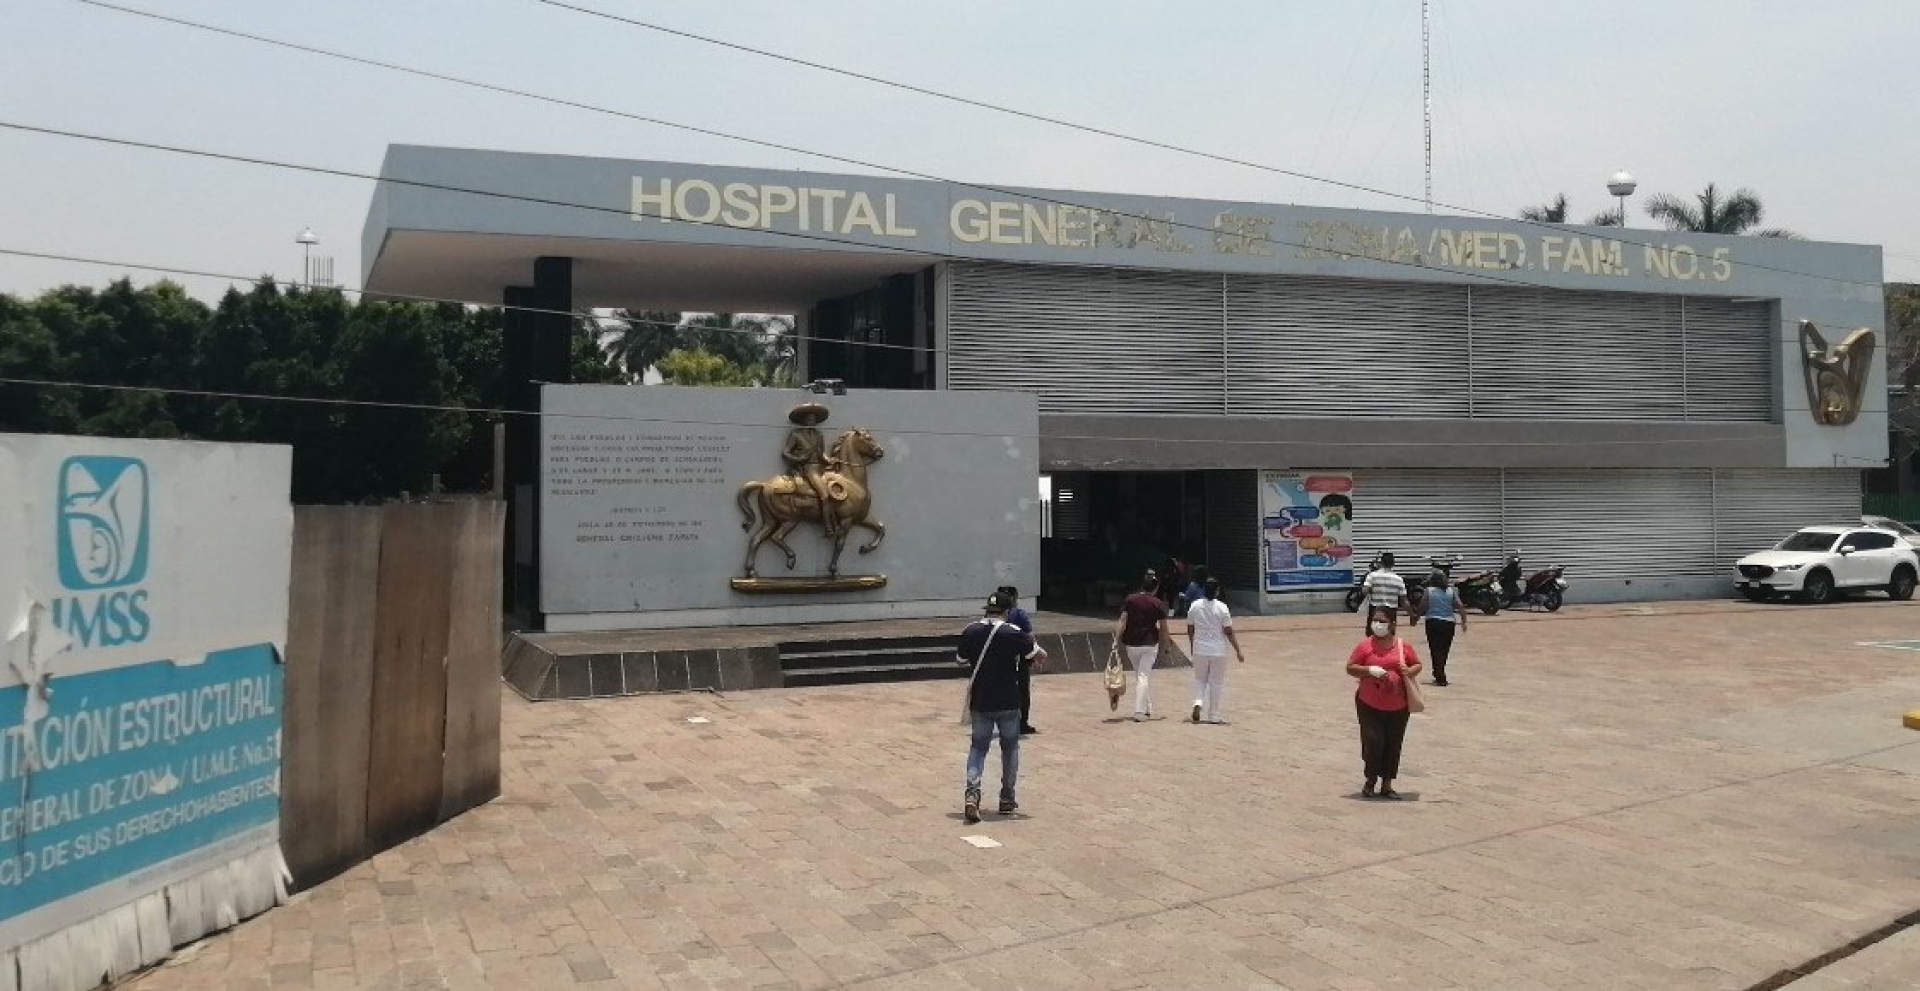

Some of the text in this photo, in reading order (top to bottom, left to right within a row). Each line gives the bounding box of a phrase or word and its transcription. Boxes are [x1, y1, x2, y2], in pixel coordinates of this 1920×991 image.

[631, 175, 916, 237] HOSPITAL
[951, 199, 1193, 252] GENERAL
[1541, 235, 1630, 277] FAM.
[52, 589, 150, 648] IMSS
[118, 674, 275, 751] ESTRUCTURAL
[41, 840, 71, 871] DE
[74, 827, 112, 860] SUS
[115, 774, 276, 846] DERECHOHABIENTES
[88, 779, 117, 815] DE
